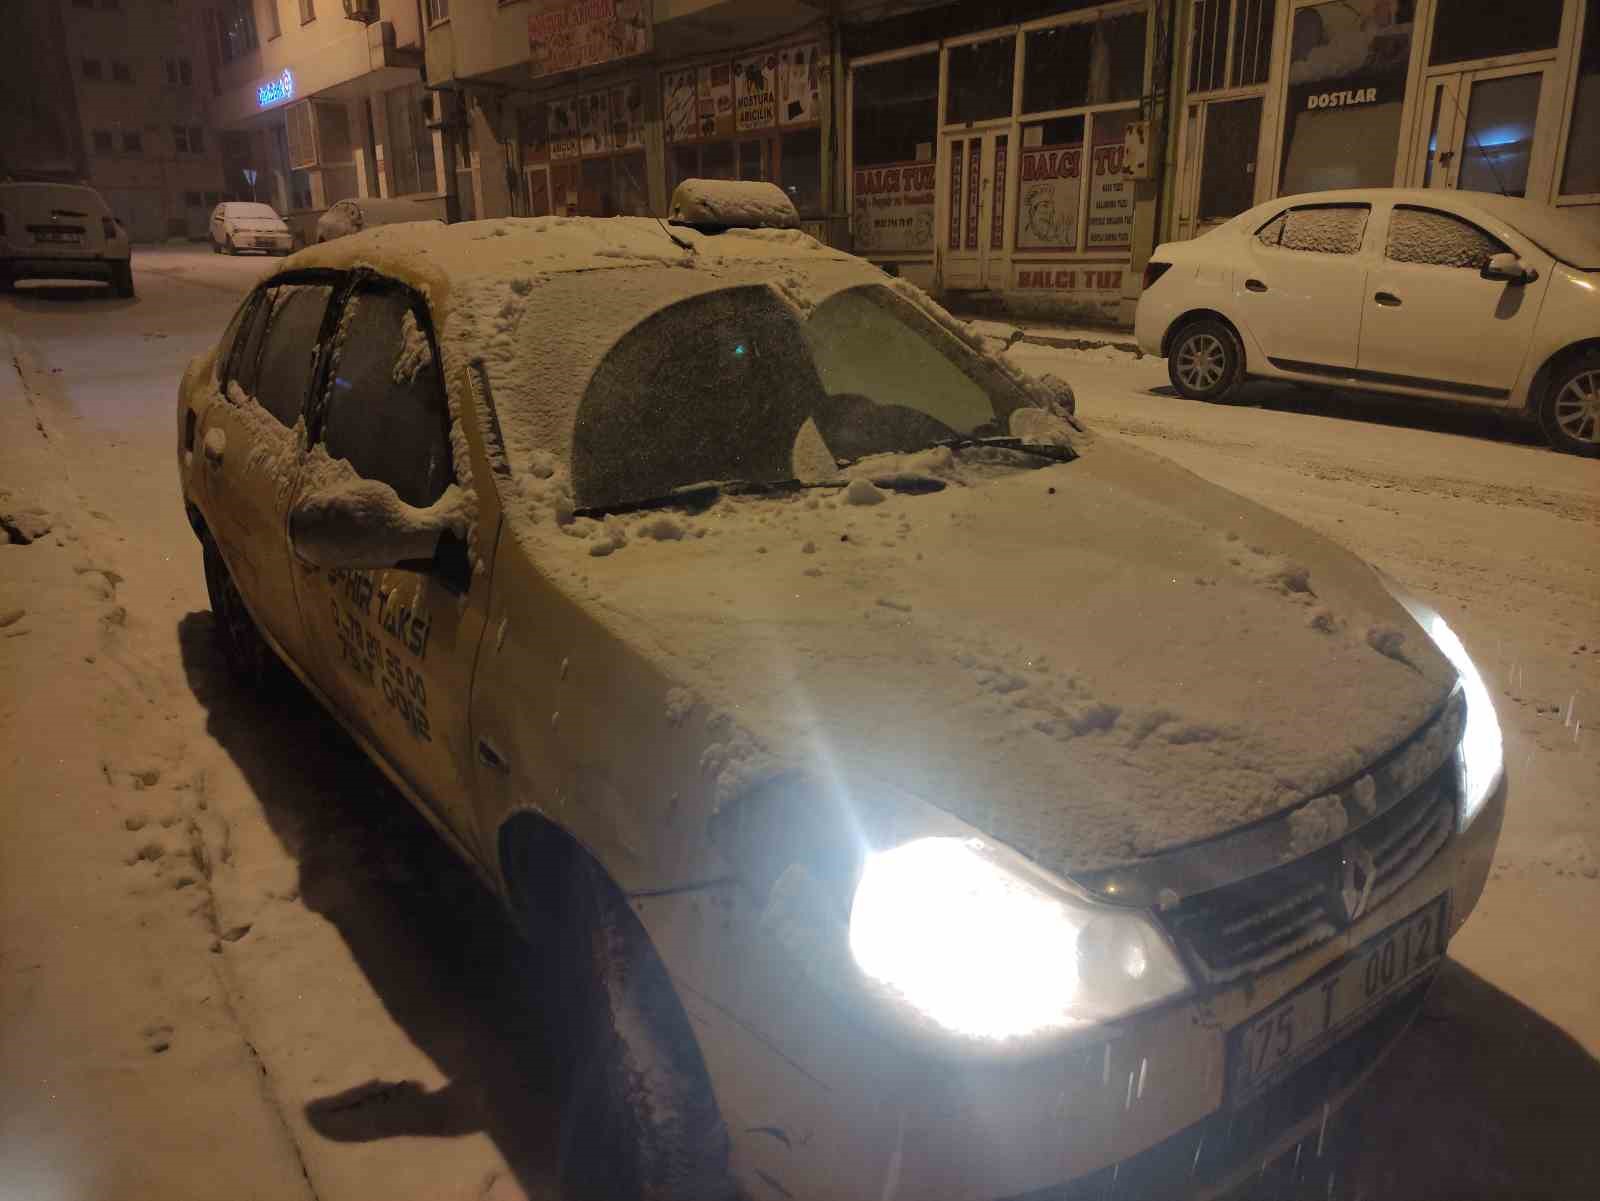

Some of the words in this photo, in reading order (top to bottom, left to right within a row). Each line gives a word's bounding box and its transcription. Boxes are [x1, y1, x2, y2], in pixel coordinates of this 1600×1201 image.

[1307, 87, 1377, 109] DOSTLAR
[1018, 271, 1075, 288] BALCI
[1084, 271, 1122, 288] TUZ
[1255, 1003, 1294, 1073] 75
[1320, 976, 1340, 1031] T
[1364, 915, 1432, 997] 0012
